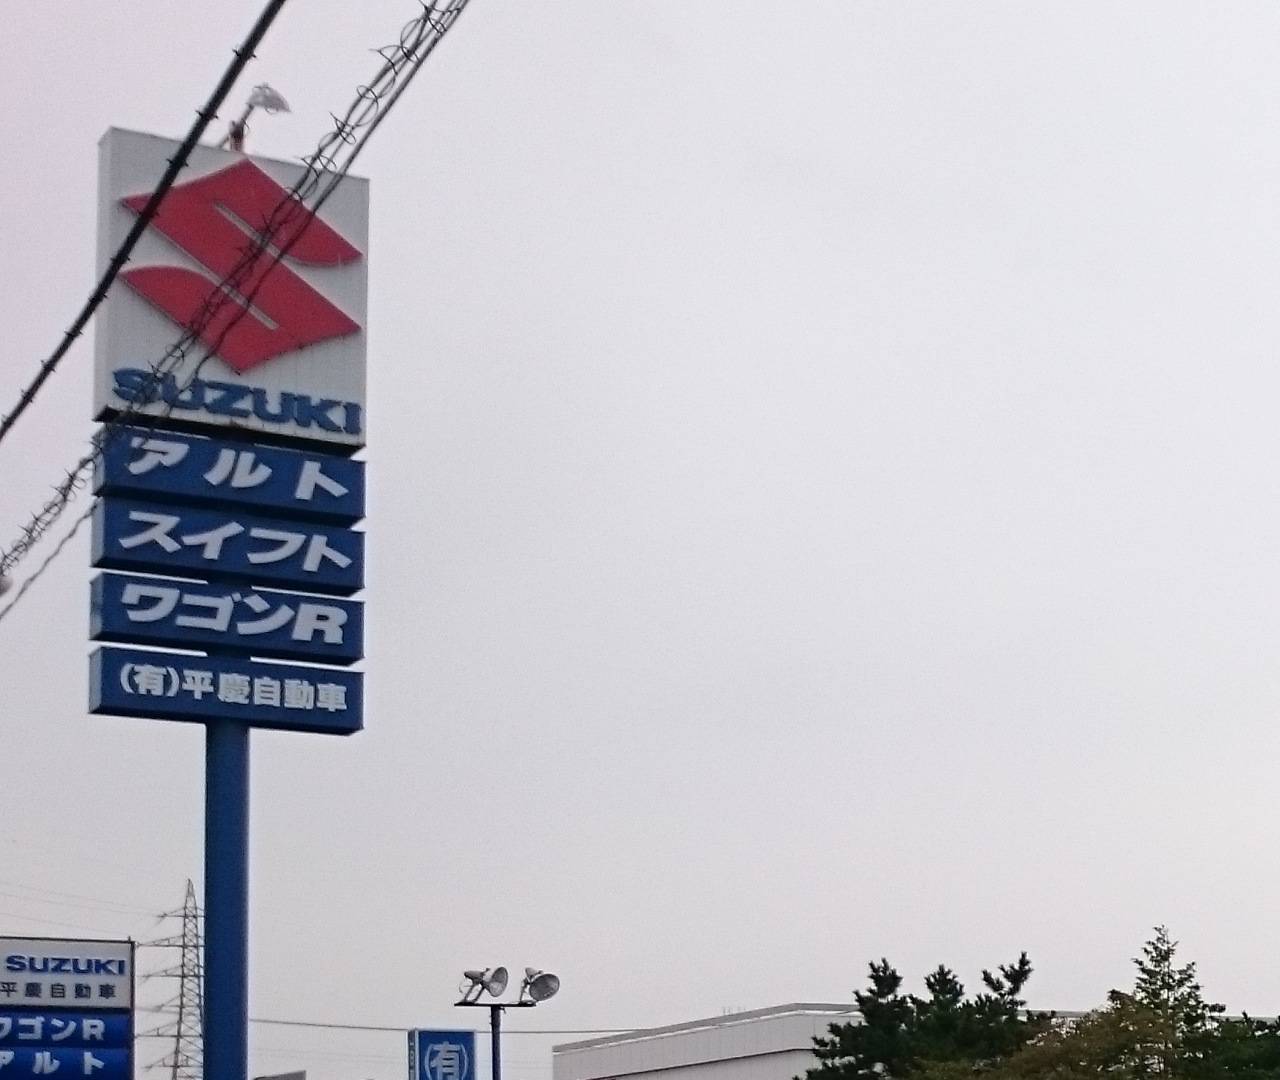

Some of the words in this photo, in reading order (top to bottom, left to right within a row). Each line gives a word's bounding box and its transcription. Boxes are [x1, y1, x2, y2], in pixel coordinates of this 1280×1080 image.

[111, 367, 362, 436] SUZUKI
[126, 436, 349, 500] アルト
[119, 510, 352, 573] スイフト
[119, 583, 349, 645] ワゴンR
[6, 955, 126, 976] SUZUKI
